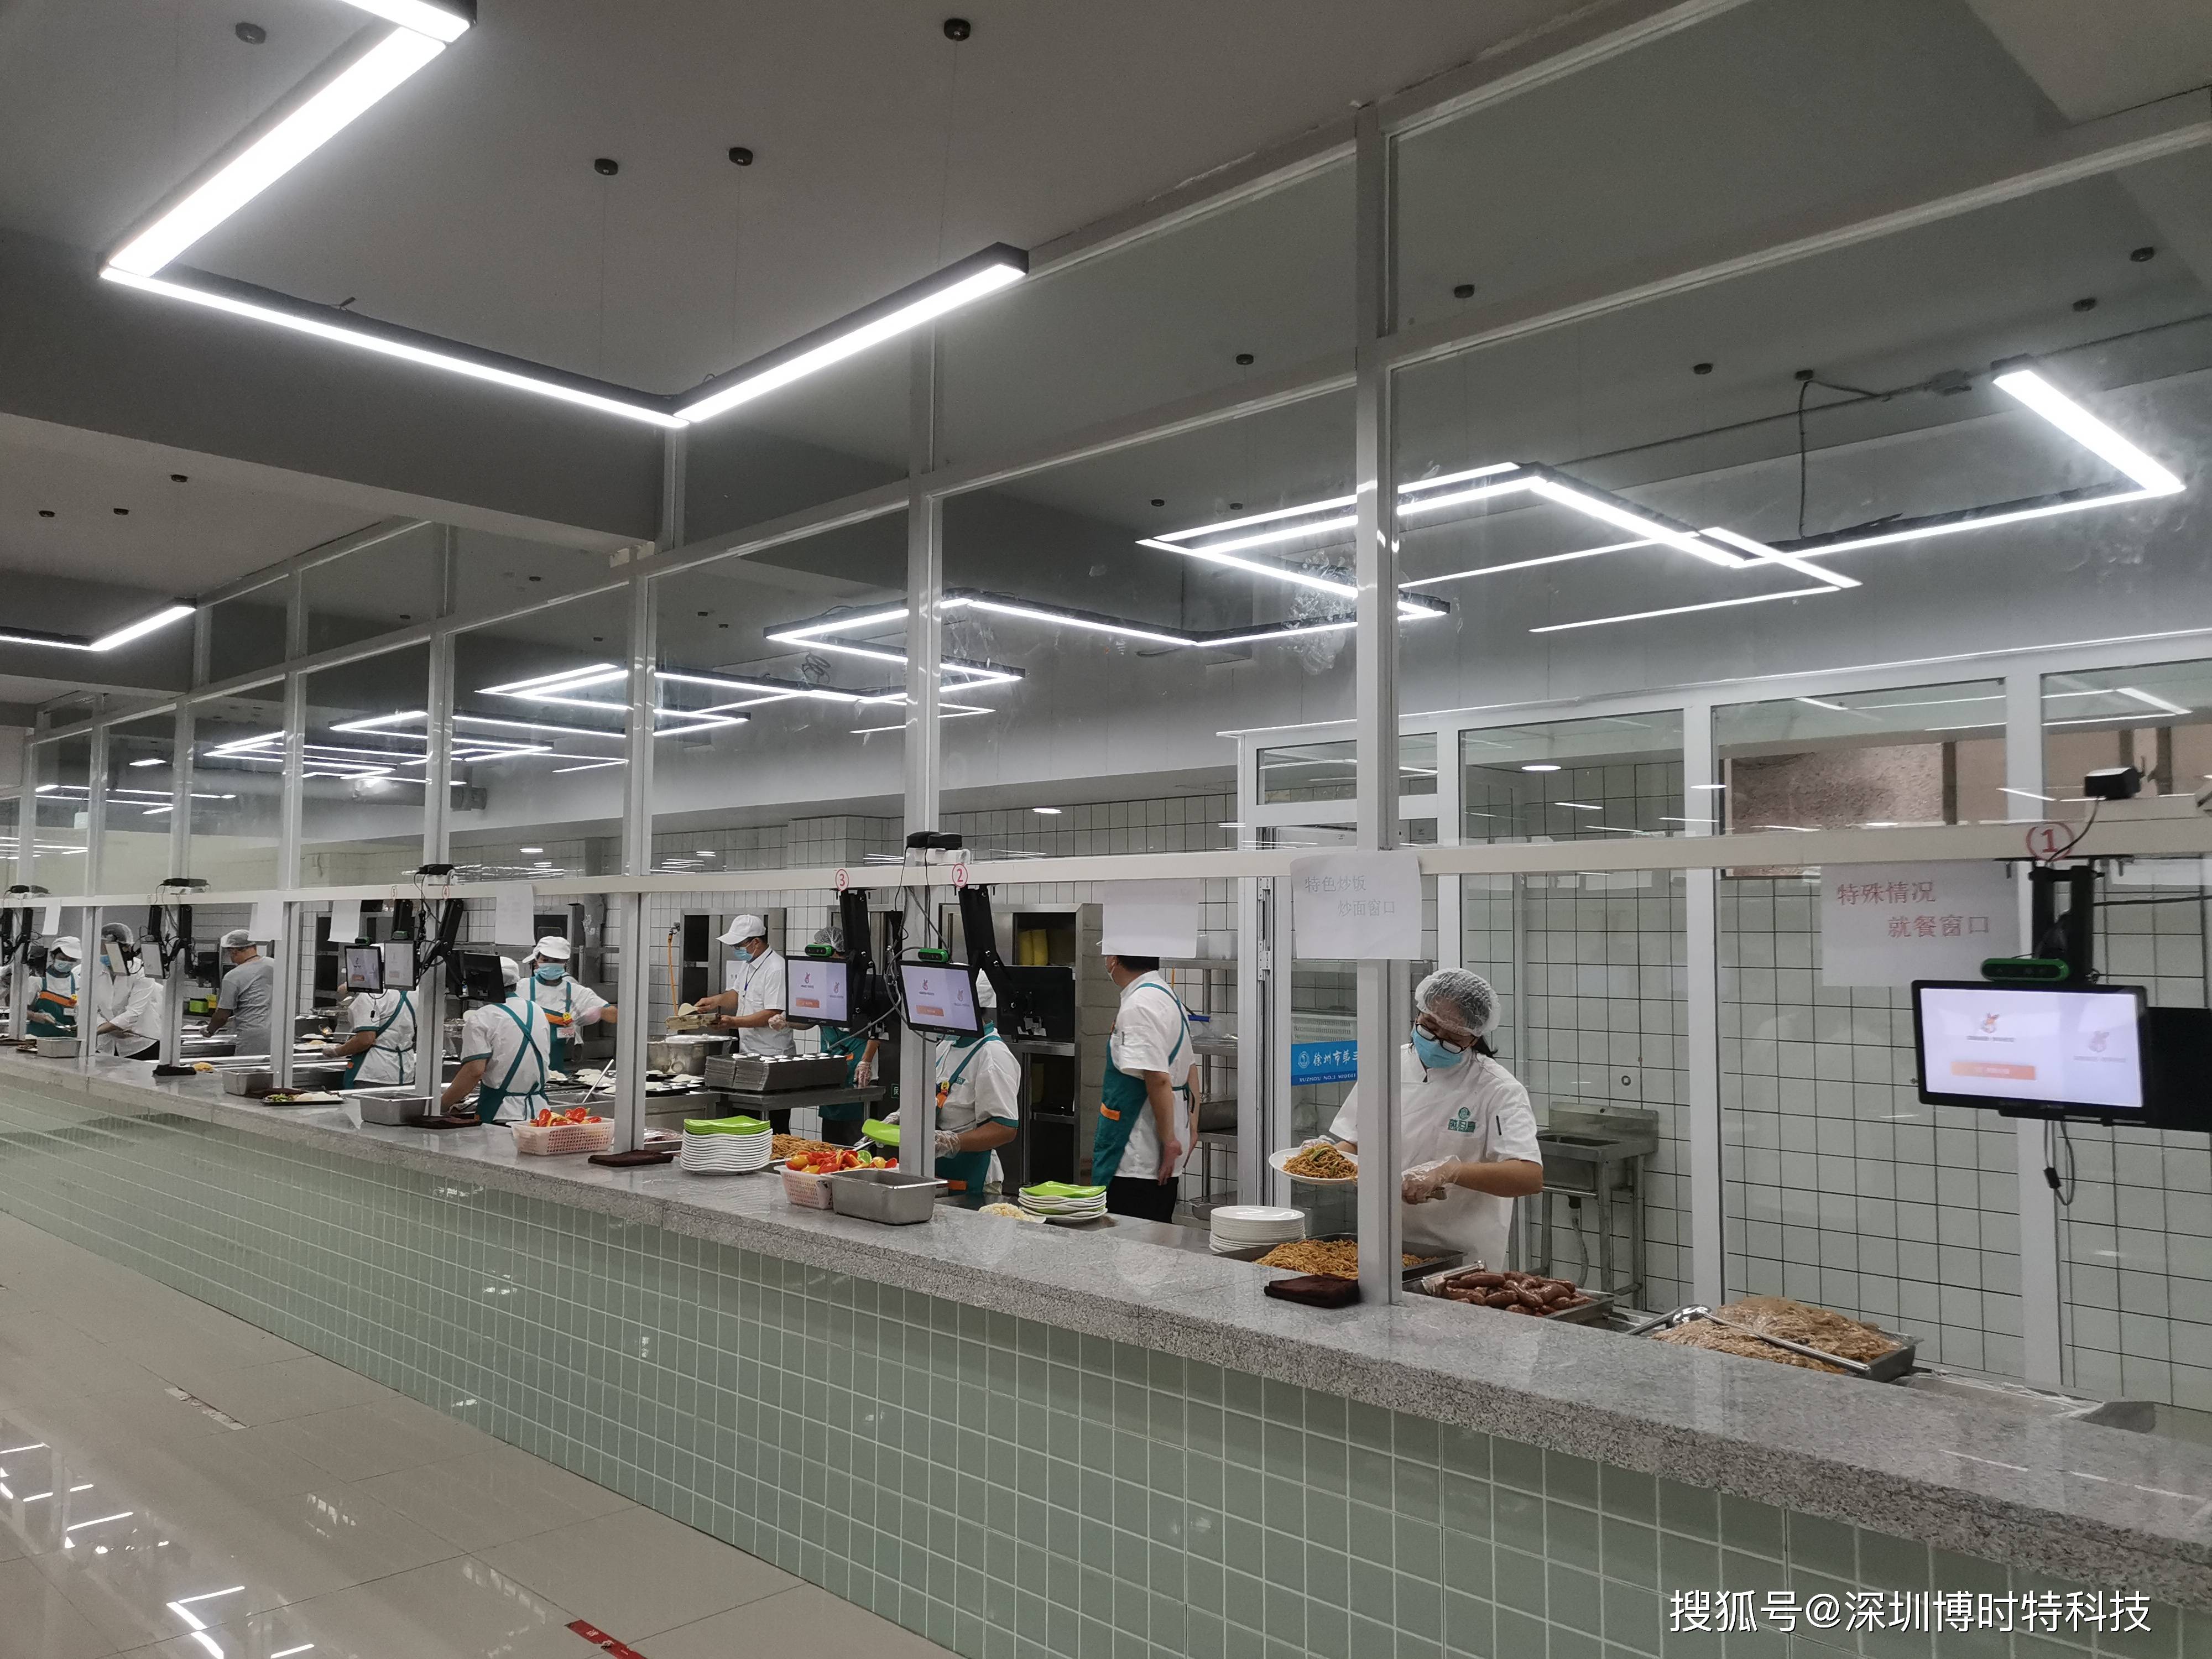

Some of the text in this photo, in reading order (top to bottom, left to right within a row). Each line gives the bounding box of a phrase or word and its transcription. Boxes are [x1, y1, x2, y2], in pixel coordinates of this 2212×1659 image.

[1305, 875, 1366, 893] 特色炒饭
[1837, 881, 1936, 905] 特殊情况
[1338, 899, 1395, 917] 炒面窗口
[1887, 914, 1990, 938] 就餐窗口
